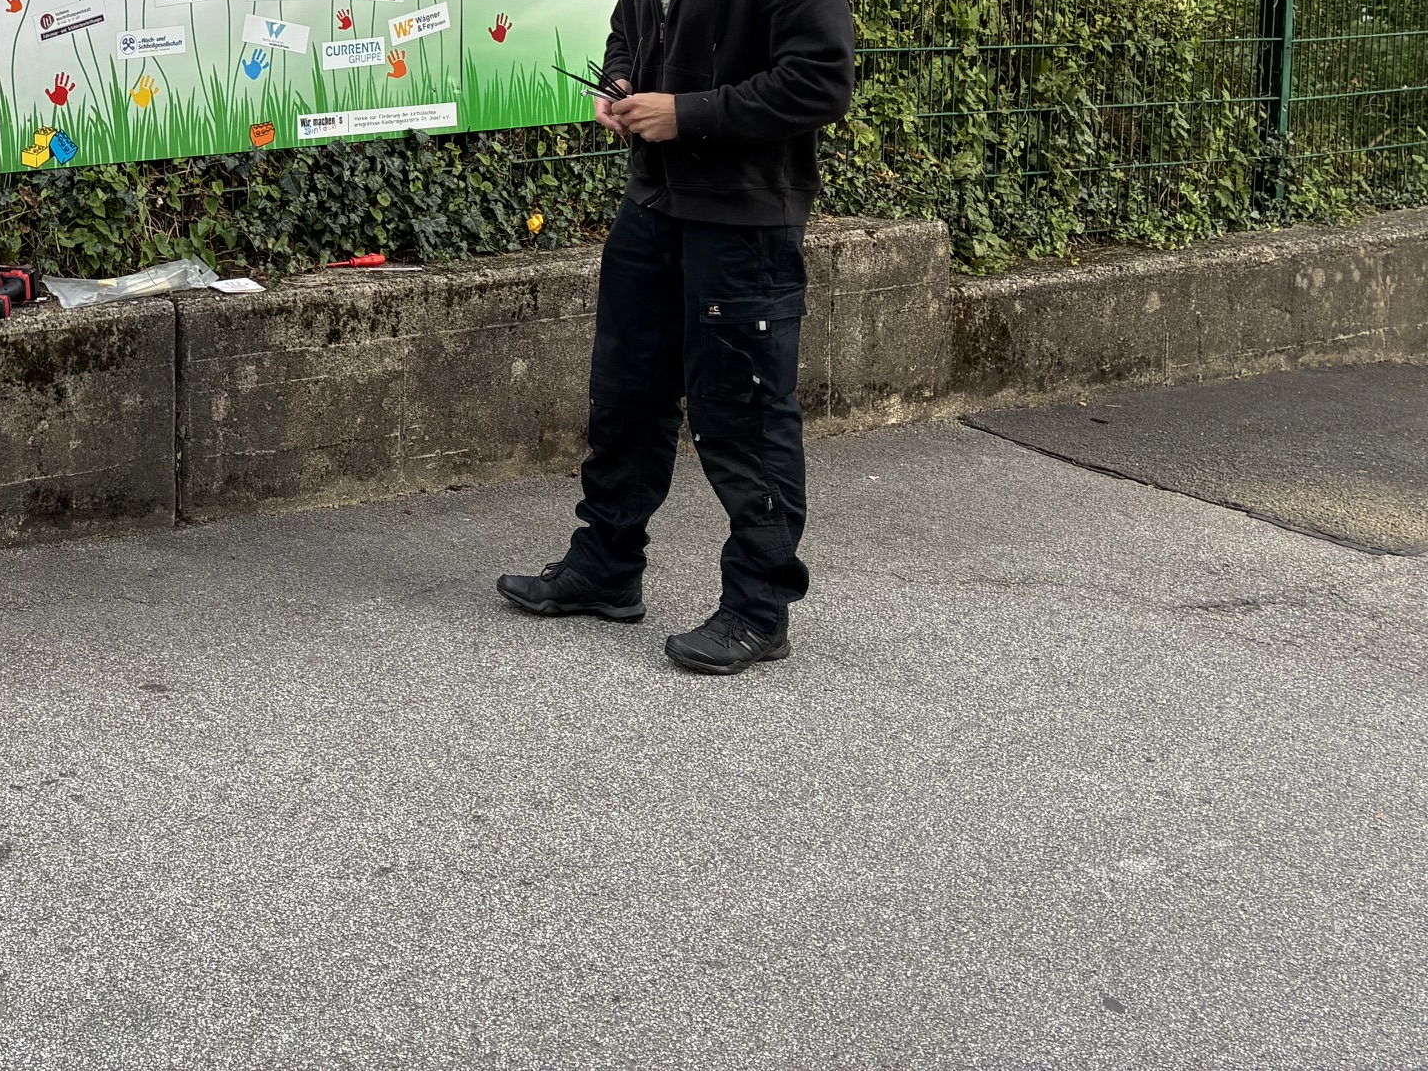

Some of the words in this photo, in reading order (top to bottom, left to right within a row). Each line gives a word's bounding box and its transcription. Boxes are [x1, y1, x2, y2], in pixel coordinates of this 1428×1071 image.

[393, 17, 414, 39] WF
[325, 41, 382, 57] CURRENTA
[348, 52, 382, 64] GRUPPE
[300, 117, 312, 128] Wir
